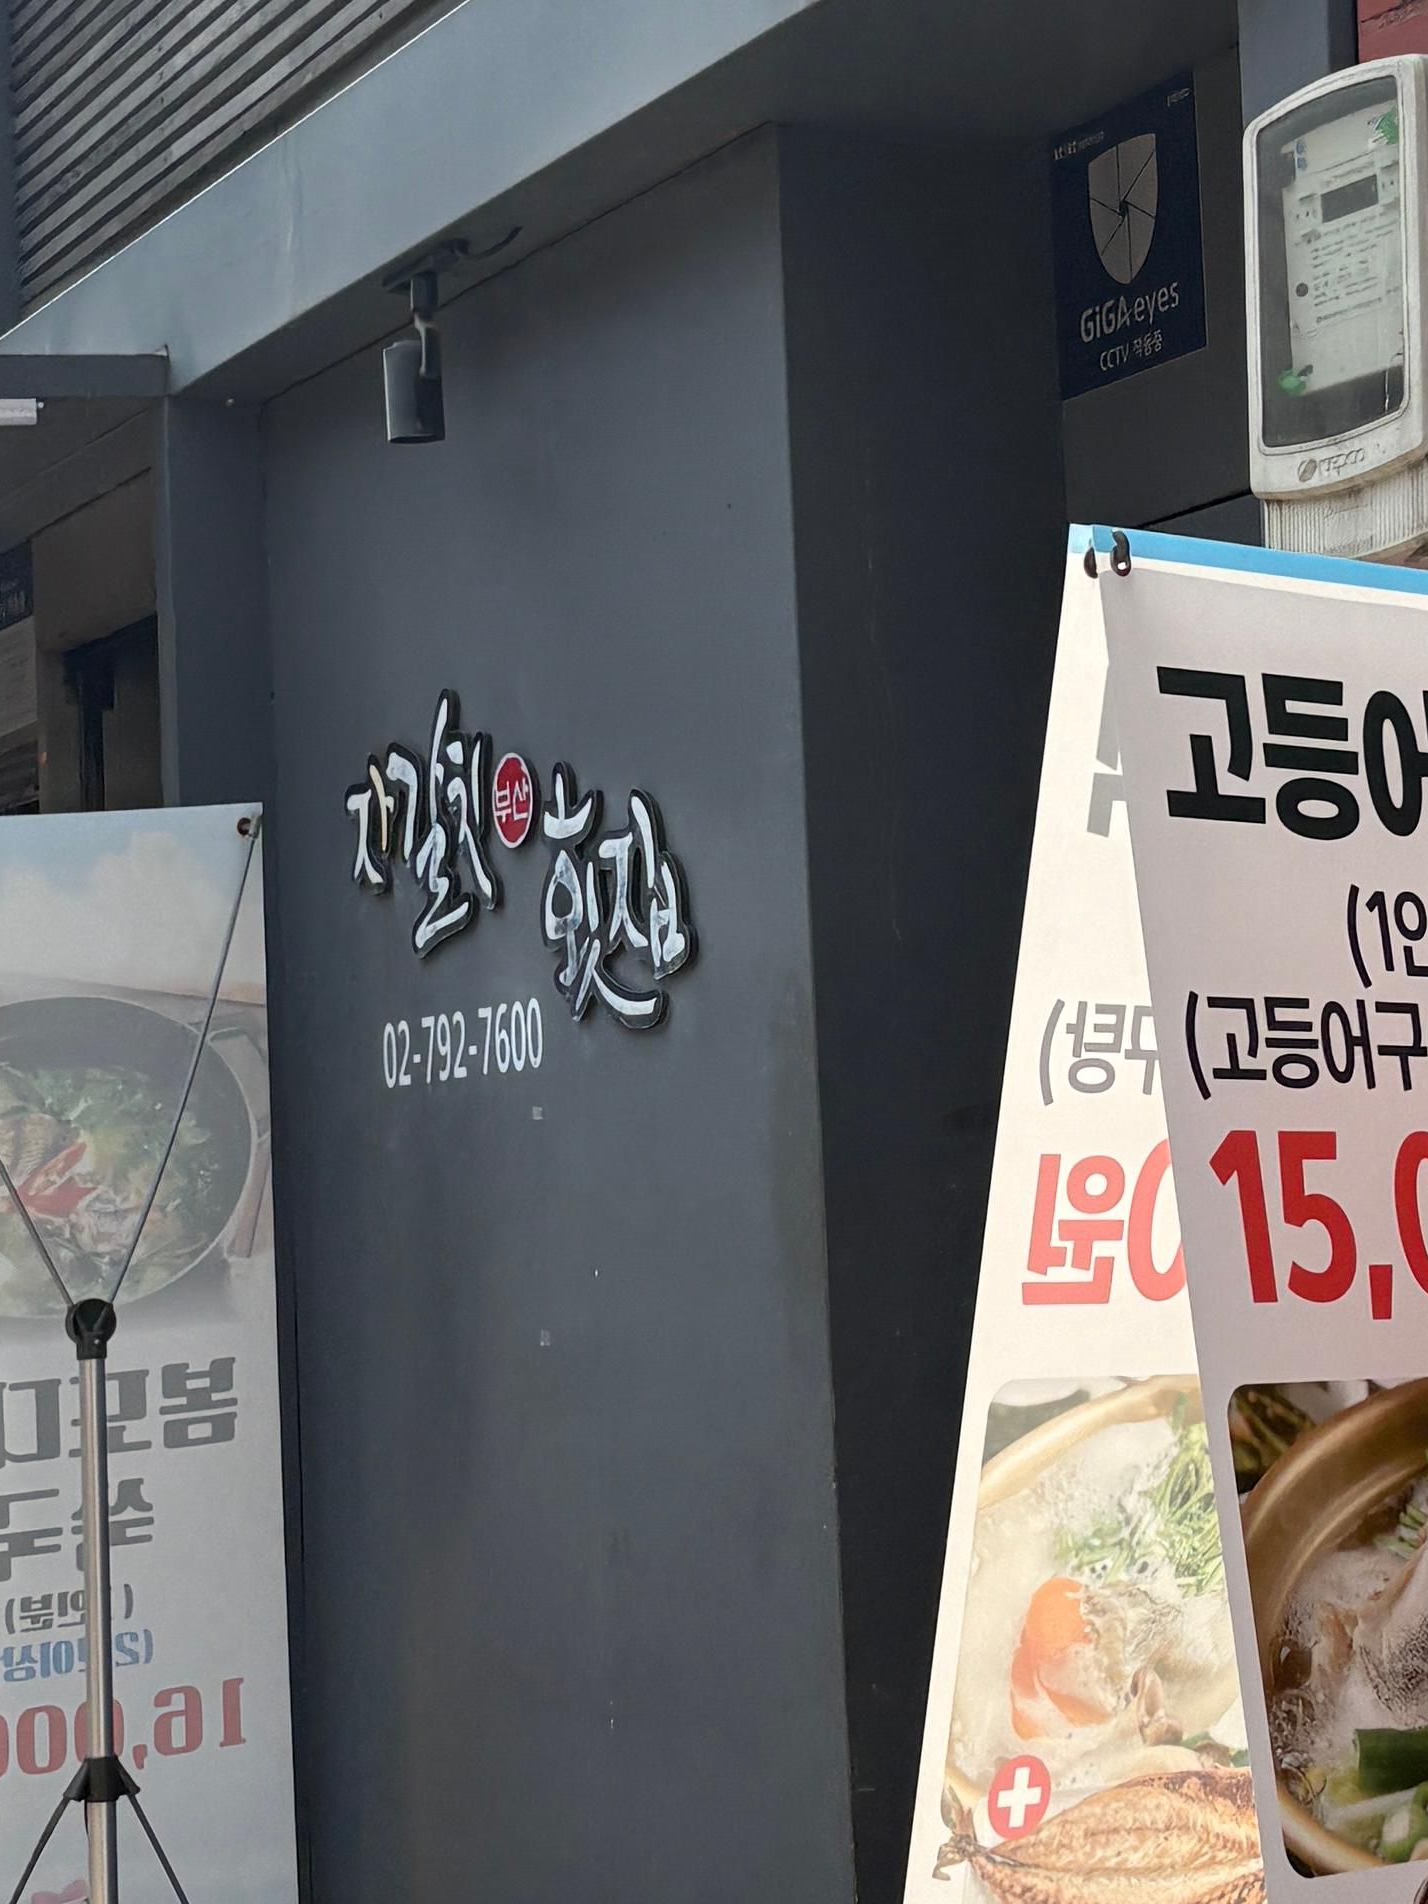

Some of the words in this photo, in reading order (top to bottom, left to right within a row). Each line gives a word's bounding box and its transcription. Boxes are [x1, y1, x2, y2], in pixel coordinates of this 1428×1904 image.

[1100, 343, 1129, 371] CCTV
[1133, 329, 1162, 357] 작동중
[346, 695, 493, 950] 자갈치
[542, 772, 686, 1020] 횟집
[383, 998, 543, 1088] 02-792-7600
